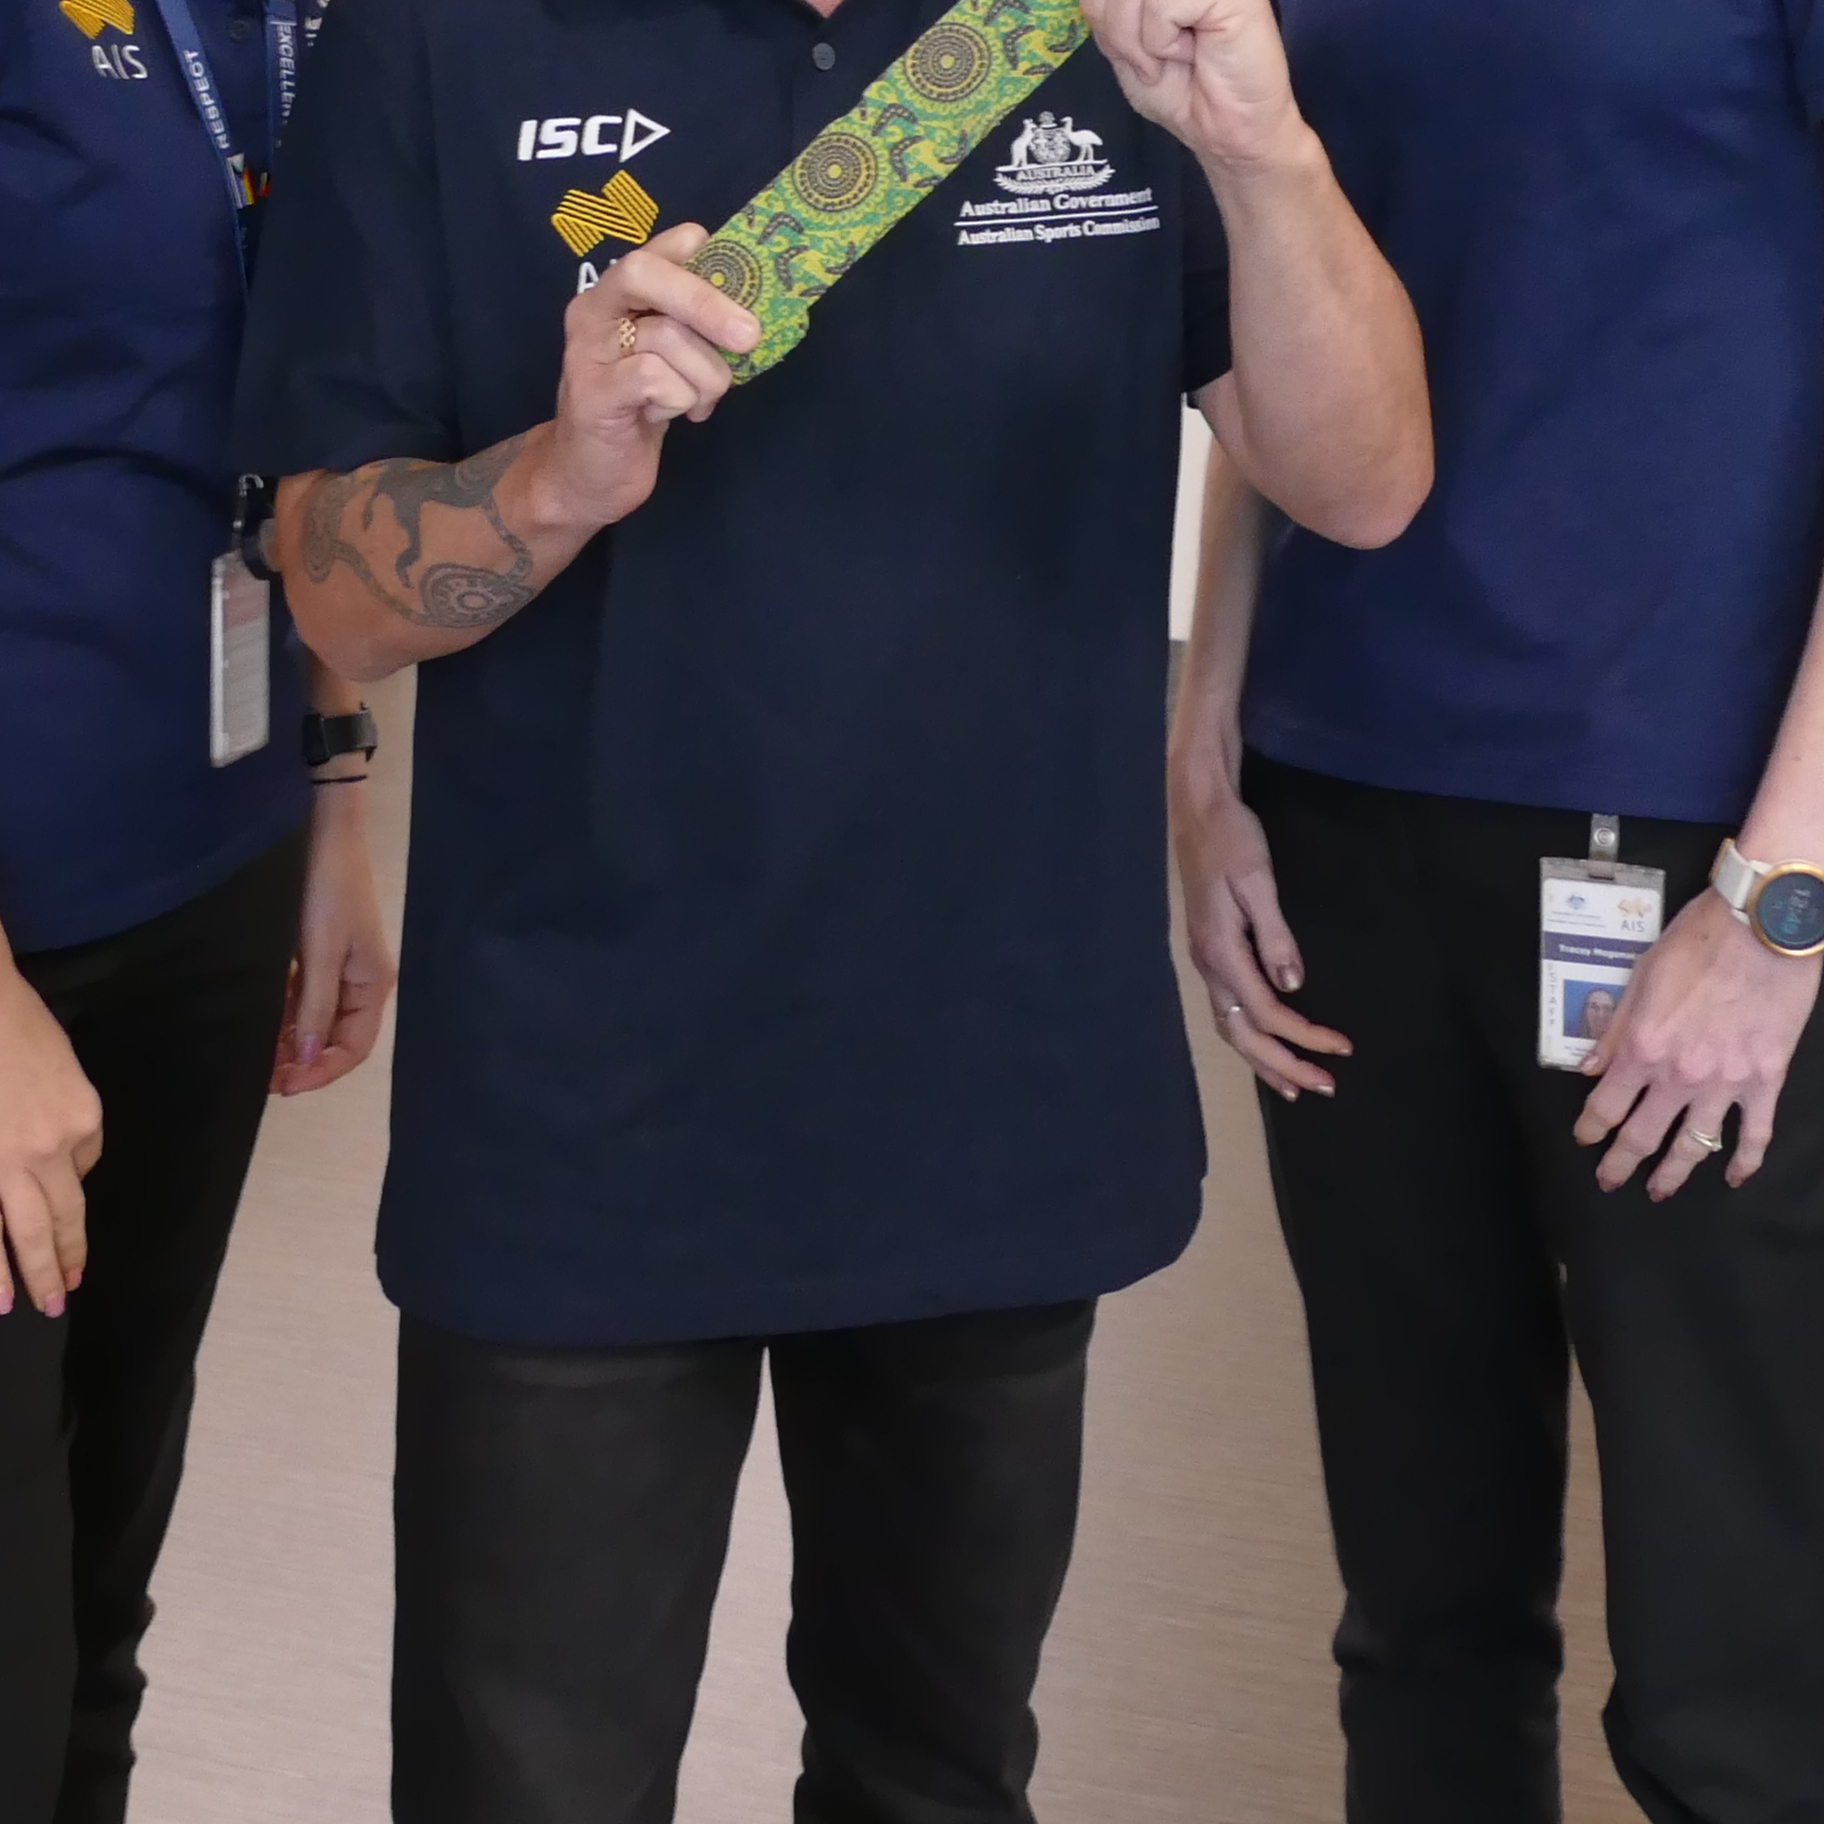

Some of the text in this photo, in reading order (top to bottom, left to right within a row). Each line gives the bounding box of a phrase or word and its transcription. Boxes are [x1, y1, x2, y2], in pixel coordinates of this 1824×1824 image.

[90, 43, 149, 80] AIS
[958, 186, 1154, 218] Australian Government
[956, 216, 1161, 246] Australian Sports Commission
[1621, 919, 1646, 933] AIS
